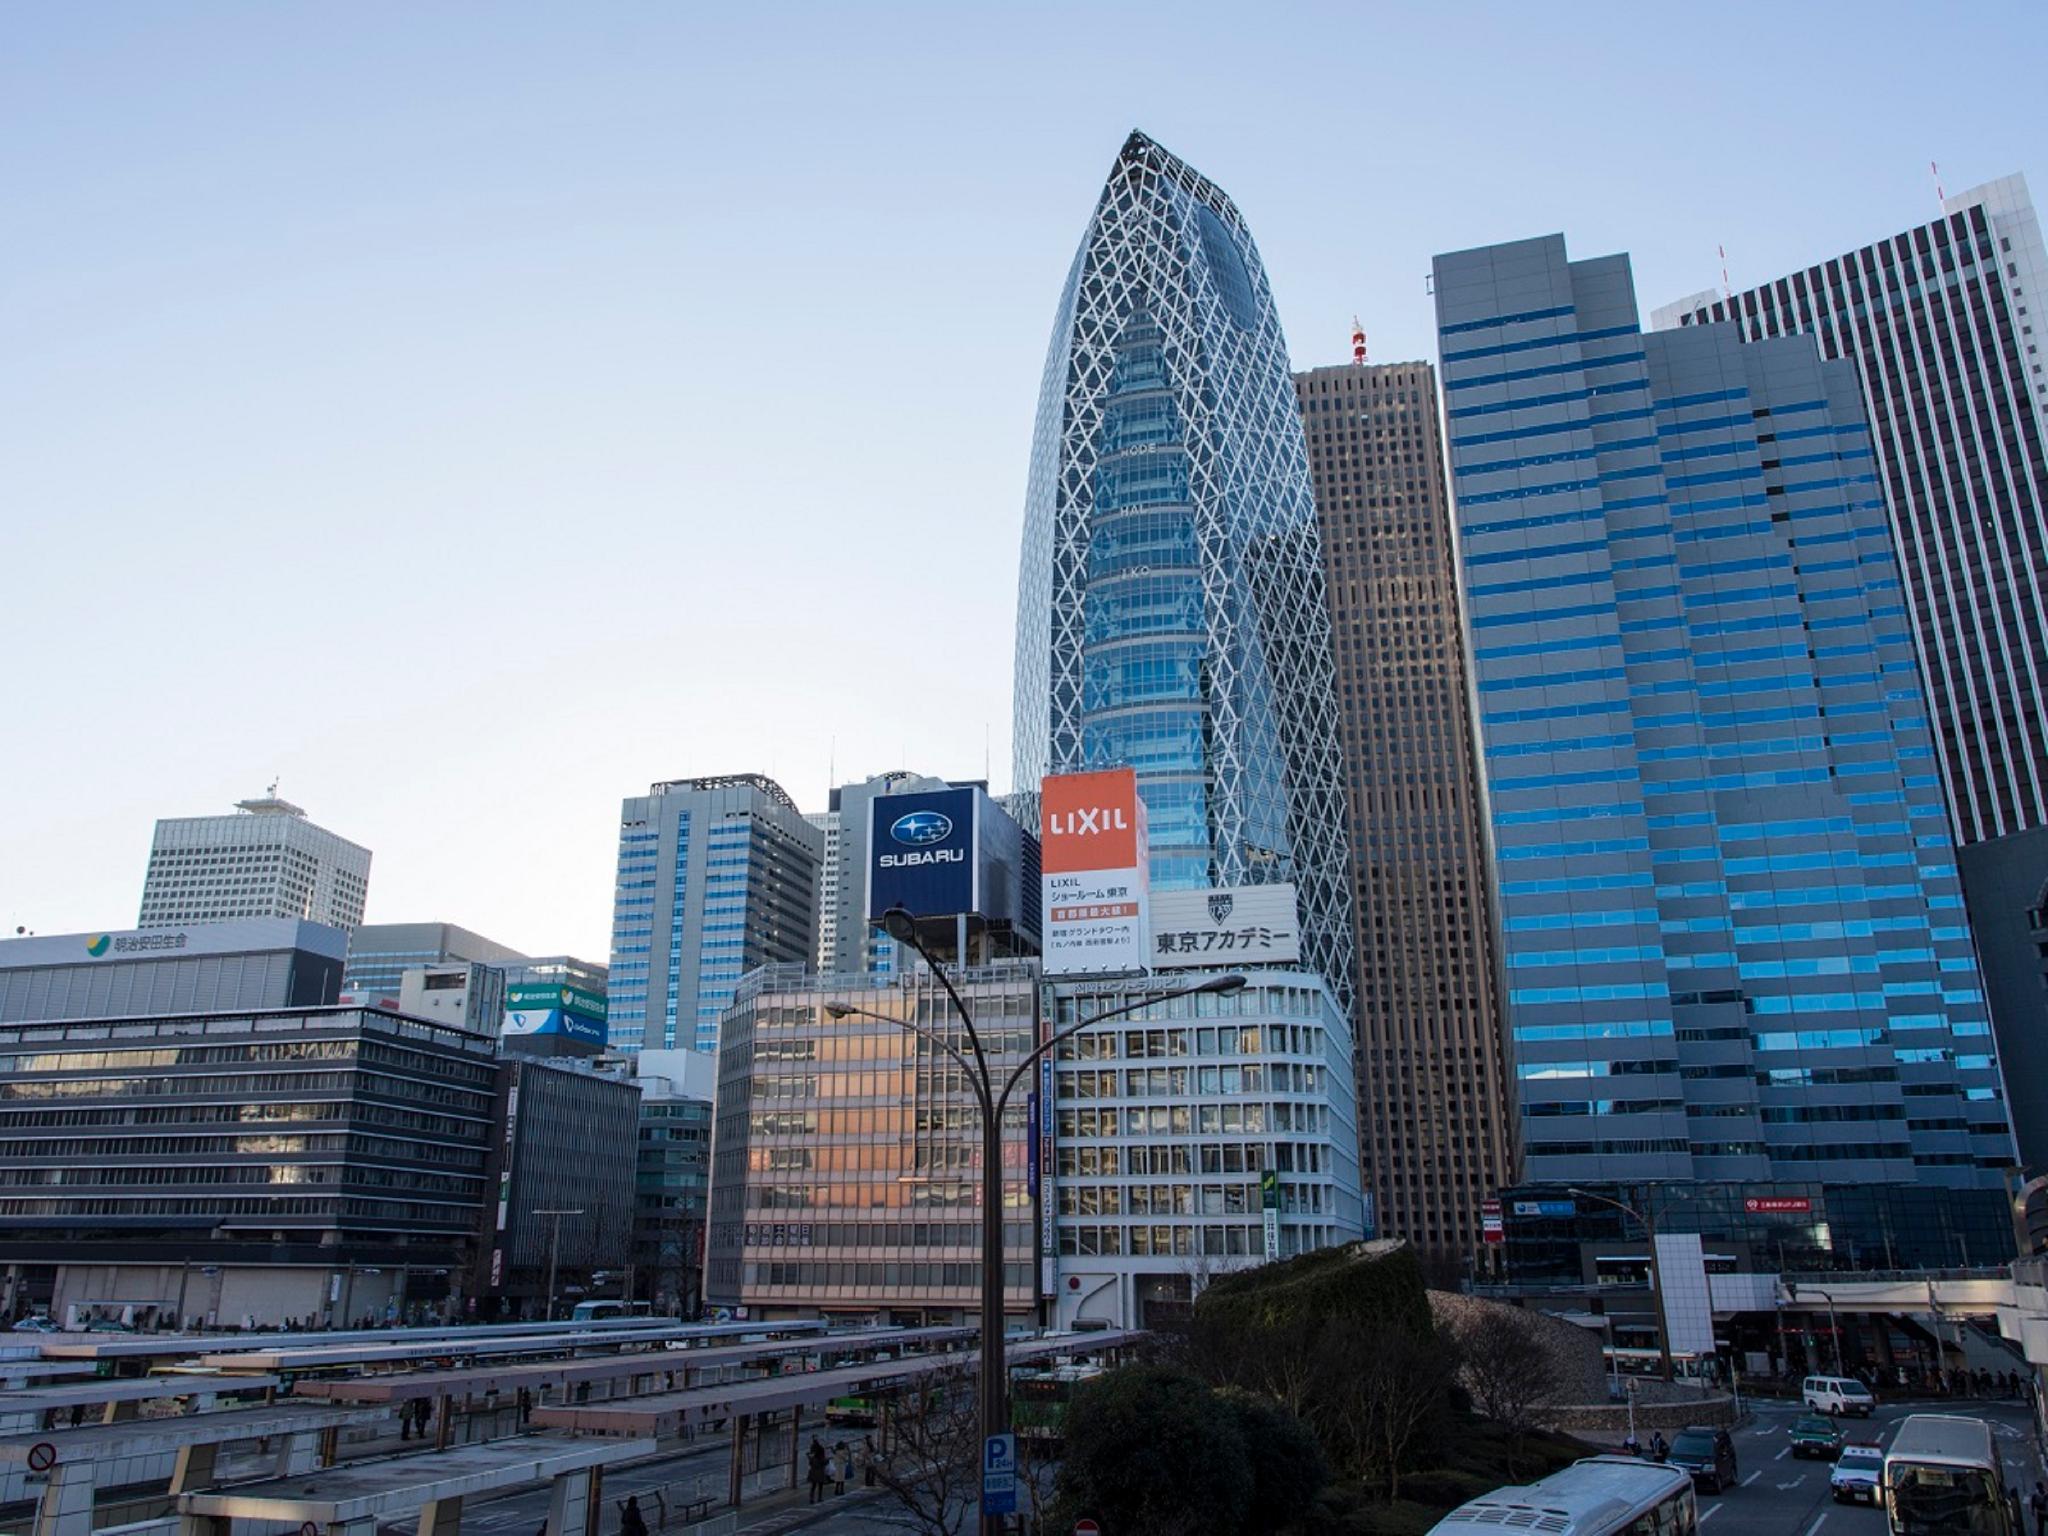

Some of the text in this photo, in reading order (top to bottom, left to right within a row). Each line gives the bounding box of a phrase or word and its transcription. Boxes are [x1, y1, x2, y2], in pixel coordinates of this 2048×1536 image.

[1121, 443, 1156, 457] MODE
[1120, 504, 1145, 517] HAL
[1050, 807, 1128, 835] LIXIL
[880, 848, 964, 868] SUBARU
[1050, 878, 1081, 888] LIXIL
[1156, 927, 1290, 954] 東京アカデミー
